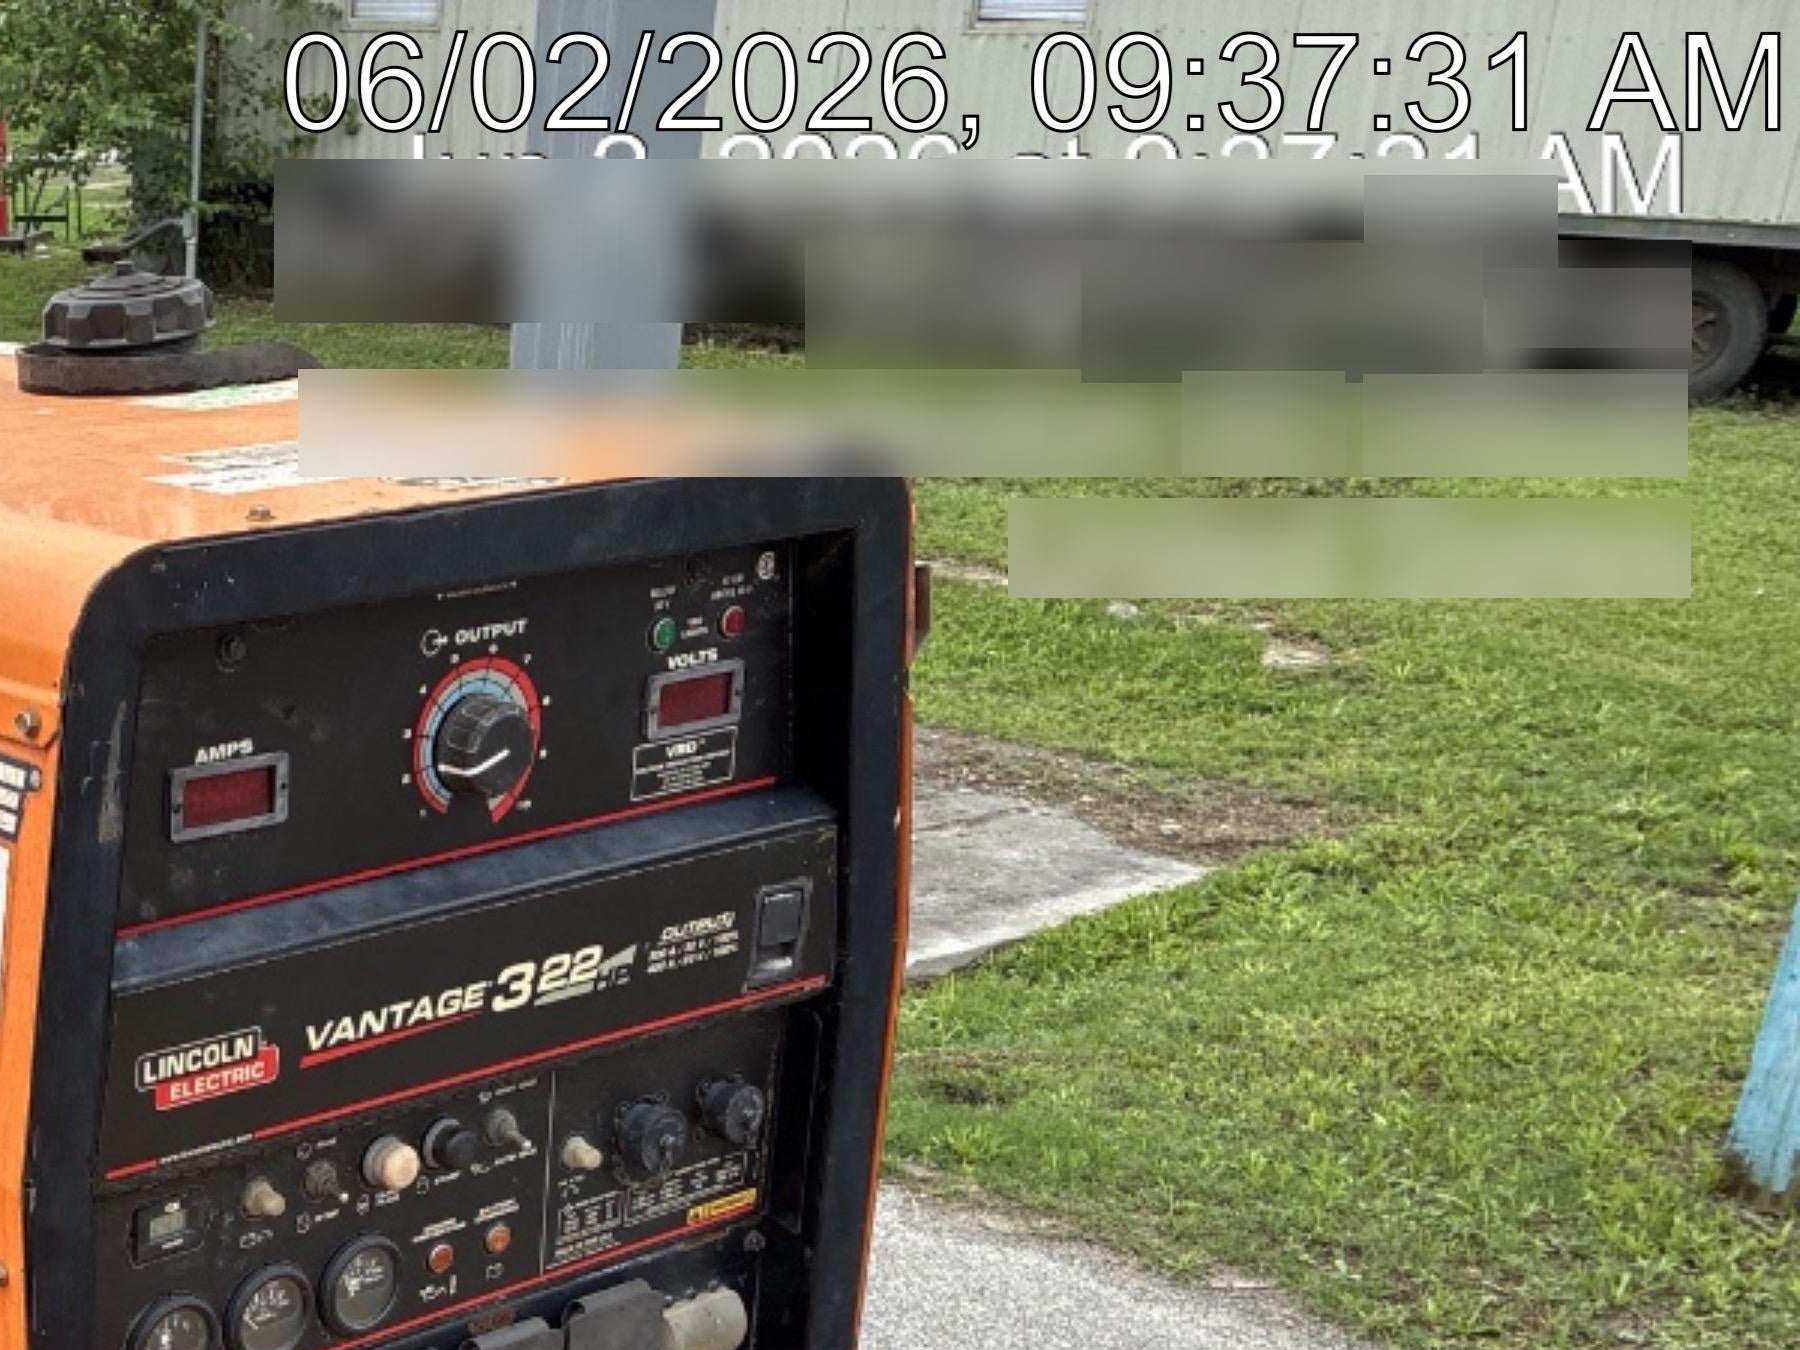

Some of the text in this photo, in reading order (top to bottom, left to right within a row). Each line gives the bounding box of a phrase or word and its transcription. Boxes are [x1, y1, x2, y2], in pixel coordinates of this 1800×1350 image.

[454, 616, 528, 646] OUTPUT
[667, 647, 718, 670] VOLTS
[194, 737, 254, 766] AMPS
[305, 981, 488, 1052] VANTAGE
[491, 944, 604, 1013] 322
[142, 1034, 254, 1084] LINCOLN
[169, 1060, 266, 1102] ELECTRIC
